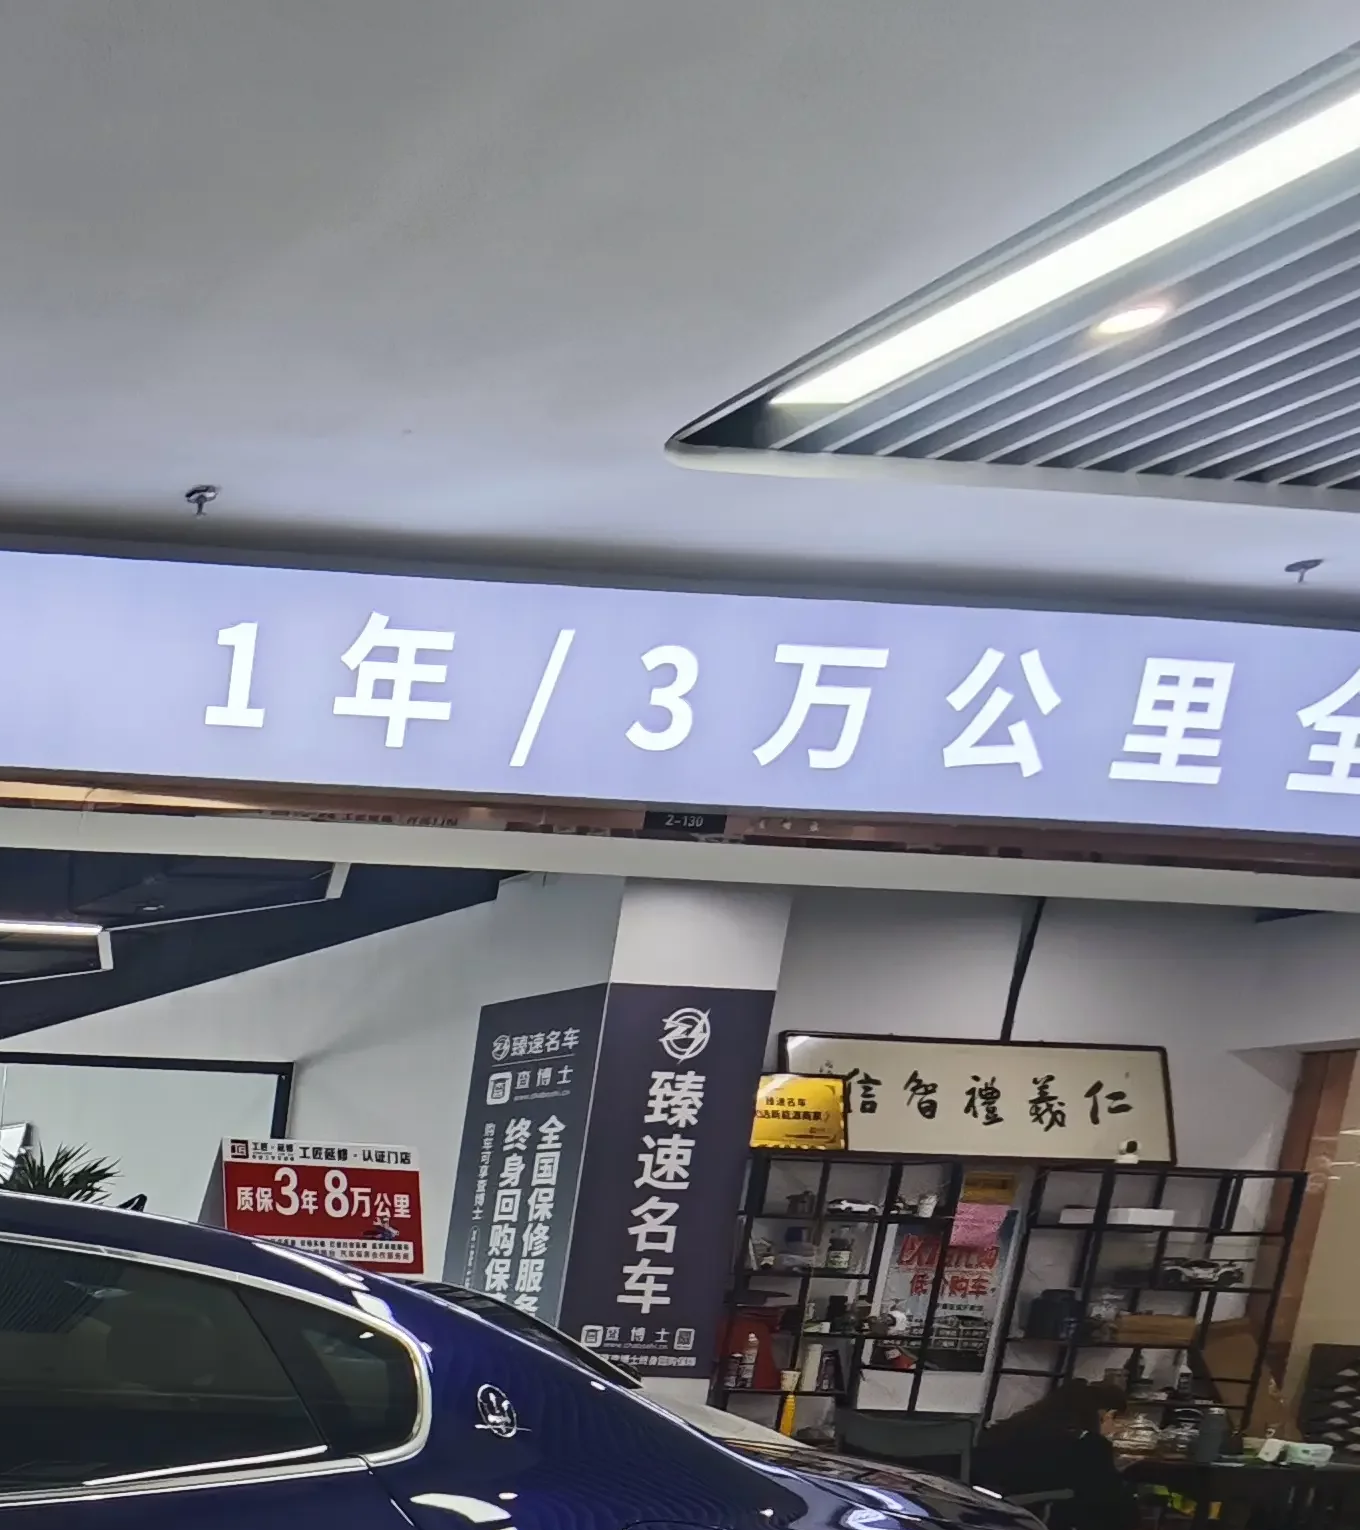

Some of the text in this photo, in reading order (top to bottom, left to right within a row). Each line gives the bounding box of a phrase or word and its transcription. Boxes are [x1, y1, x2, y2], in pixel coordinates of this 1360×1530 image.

[665, 812, 704, 829] 2-130
[511, 1027, 580, 1056] 臻速名车
[485, 1118, 532, 1303] 终身回购保
[617, 1070, 705, 1314] 臻速名车
